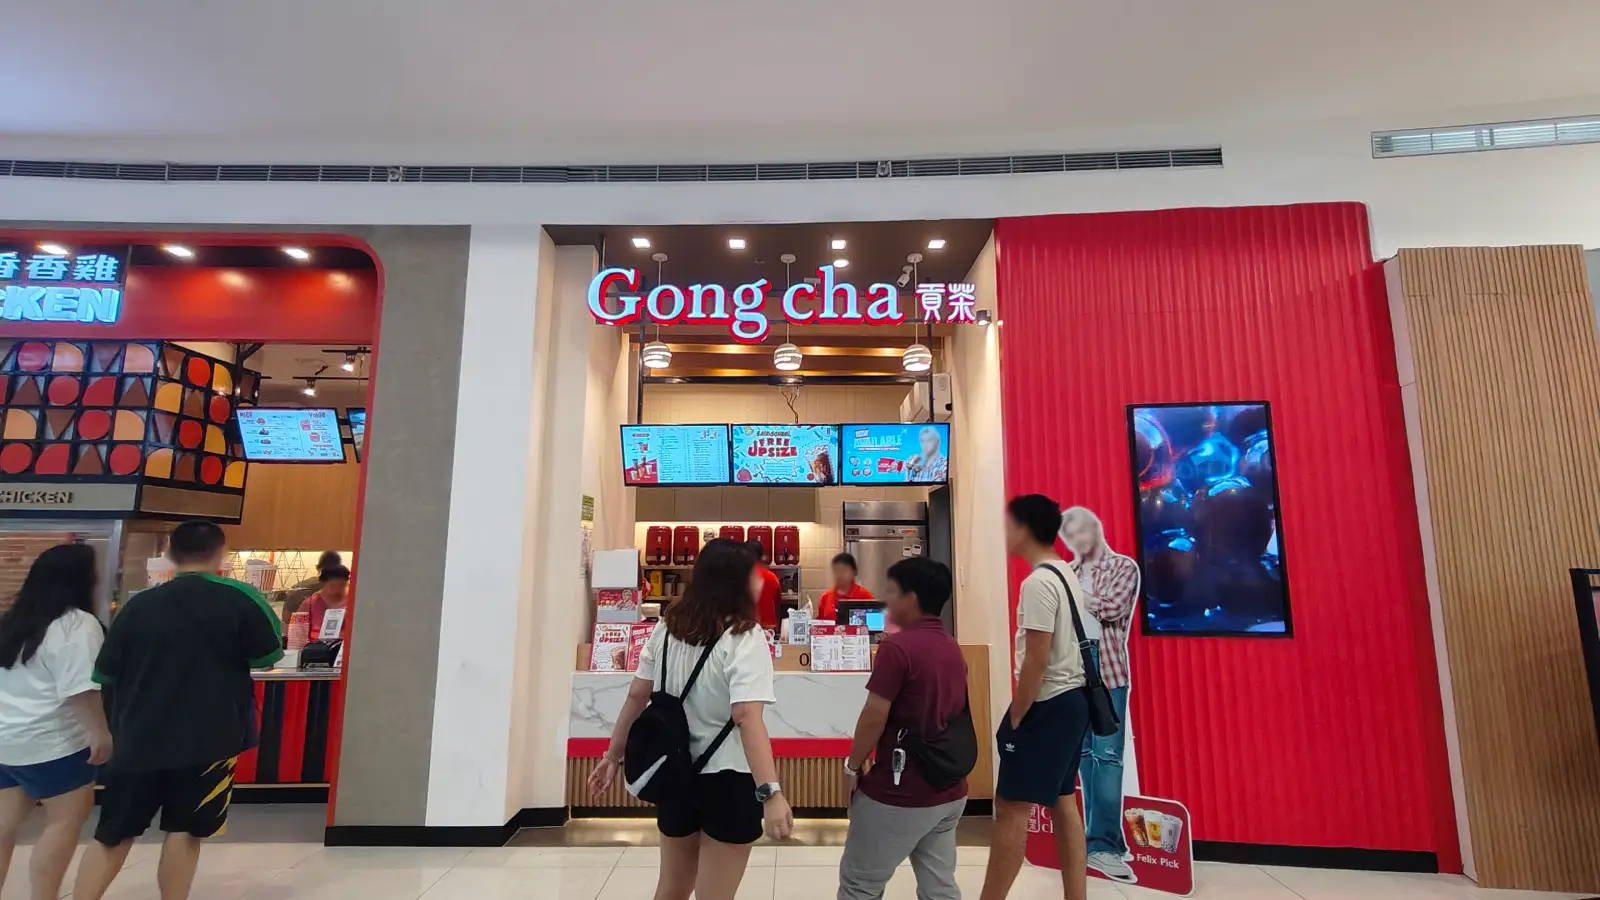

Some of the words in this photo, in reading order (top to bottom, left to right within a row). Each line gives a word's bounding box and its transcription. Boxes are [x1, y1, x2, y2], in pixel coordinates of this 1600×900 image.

[0, 286, 120, 323] KEN
[587, 267, 771, 342] Gong
[783, 265, 903, 325] cha
[915, 283, 976, 323] 貢茶
[1136, 853, 1157, 865] Felix
[1160, 857, 1180, 869] Pick
